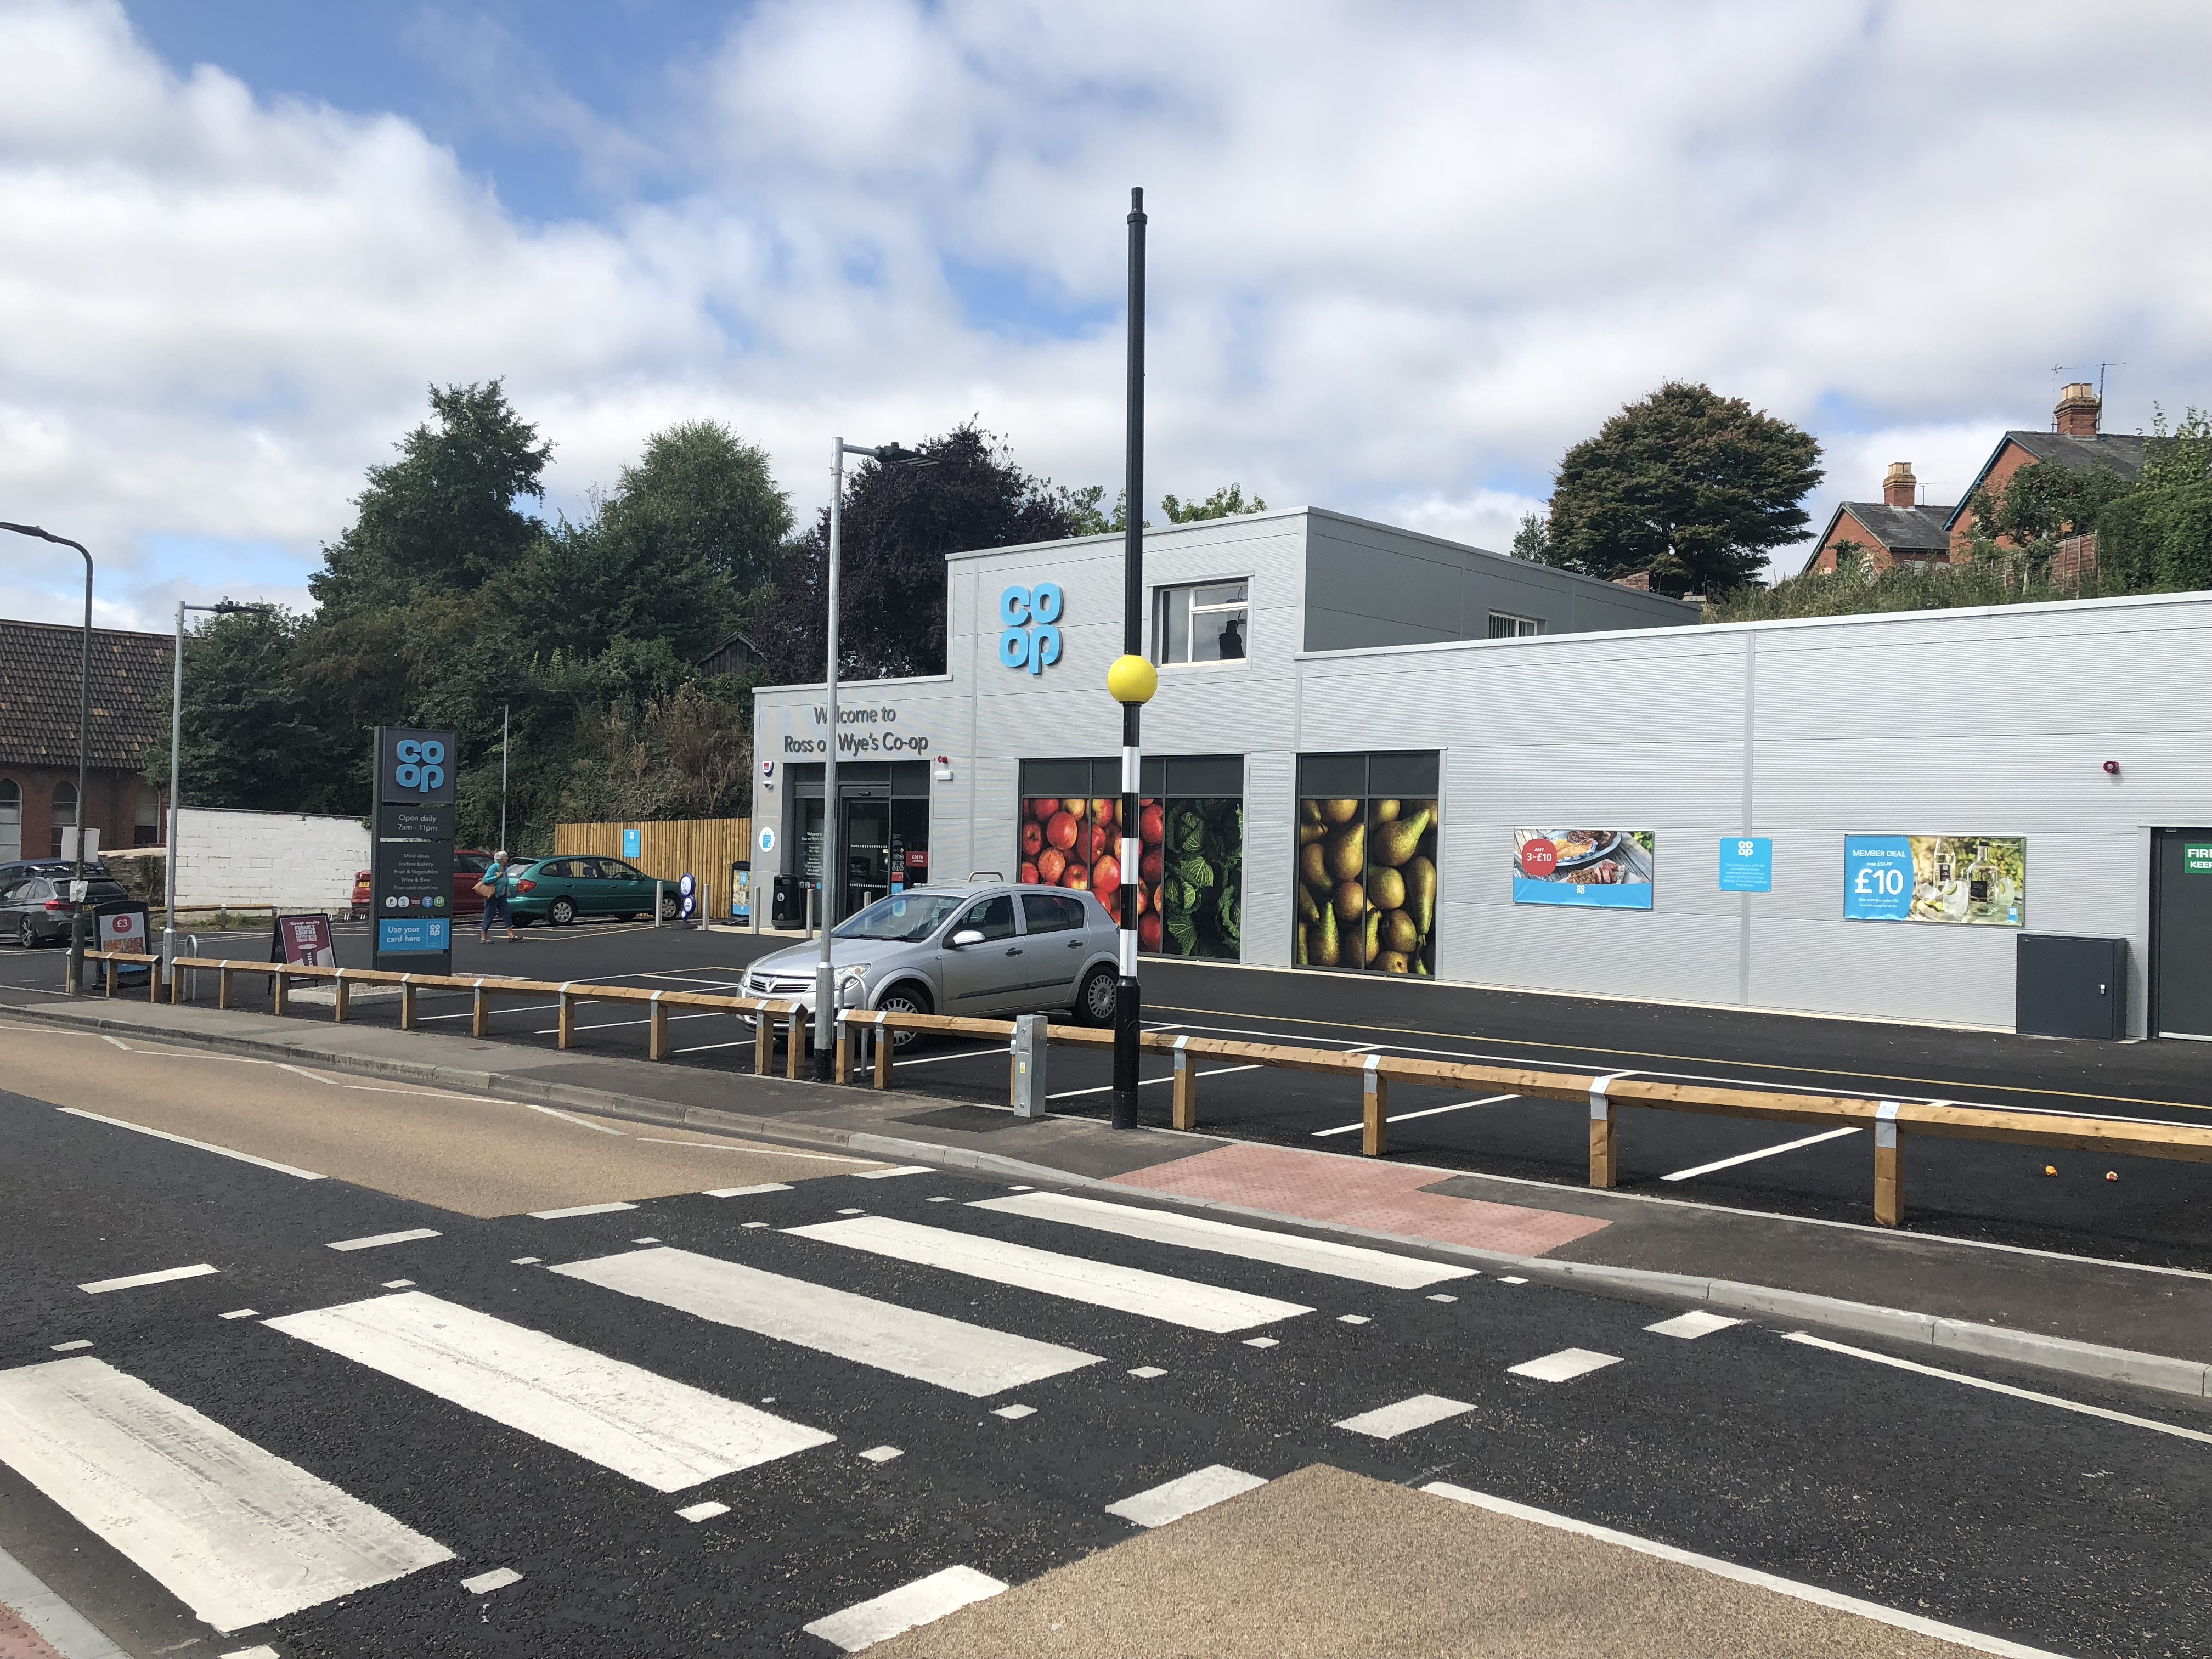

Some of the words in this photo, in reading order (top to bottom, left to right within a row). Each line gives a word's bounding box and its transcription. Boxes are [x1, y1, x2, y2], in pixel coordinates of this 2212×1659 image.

[814, 705, 878, 724] Wlcome
[881, 706, 896, 722] to
[785, 735, 814, 753] Ross
[817, 739, 826, 753] o
[838, 732, 879, 757] Wye's
[882, 731, 929, 755] Co-op
[399, 814, 418, 822] Open
[420, 815, 436, 823] daily
[1537, 853, 1552, 862] £10
[1854, 868, 1904, 895] £10
[116, 919, 128, 928] £3
